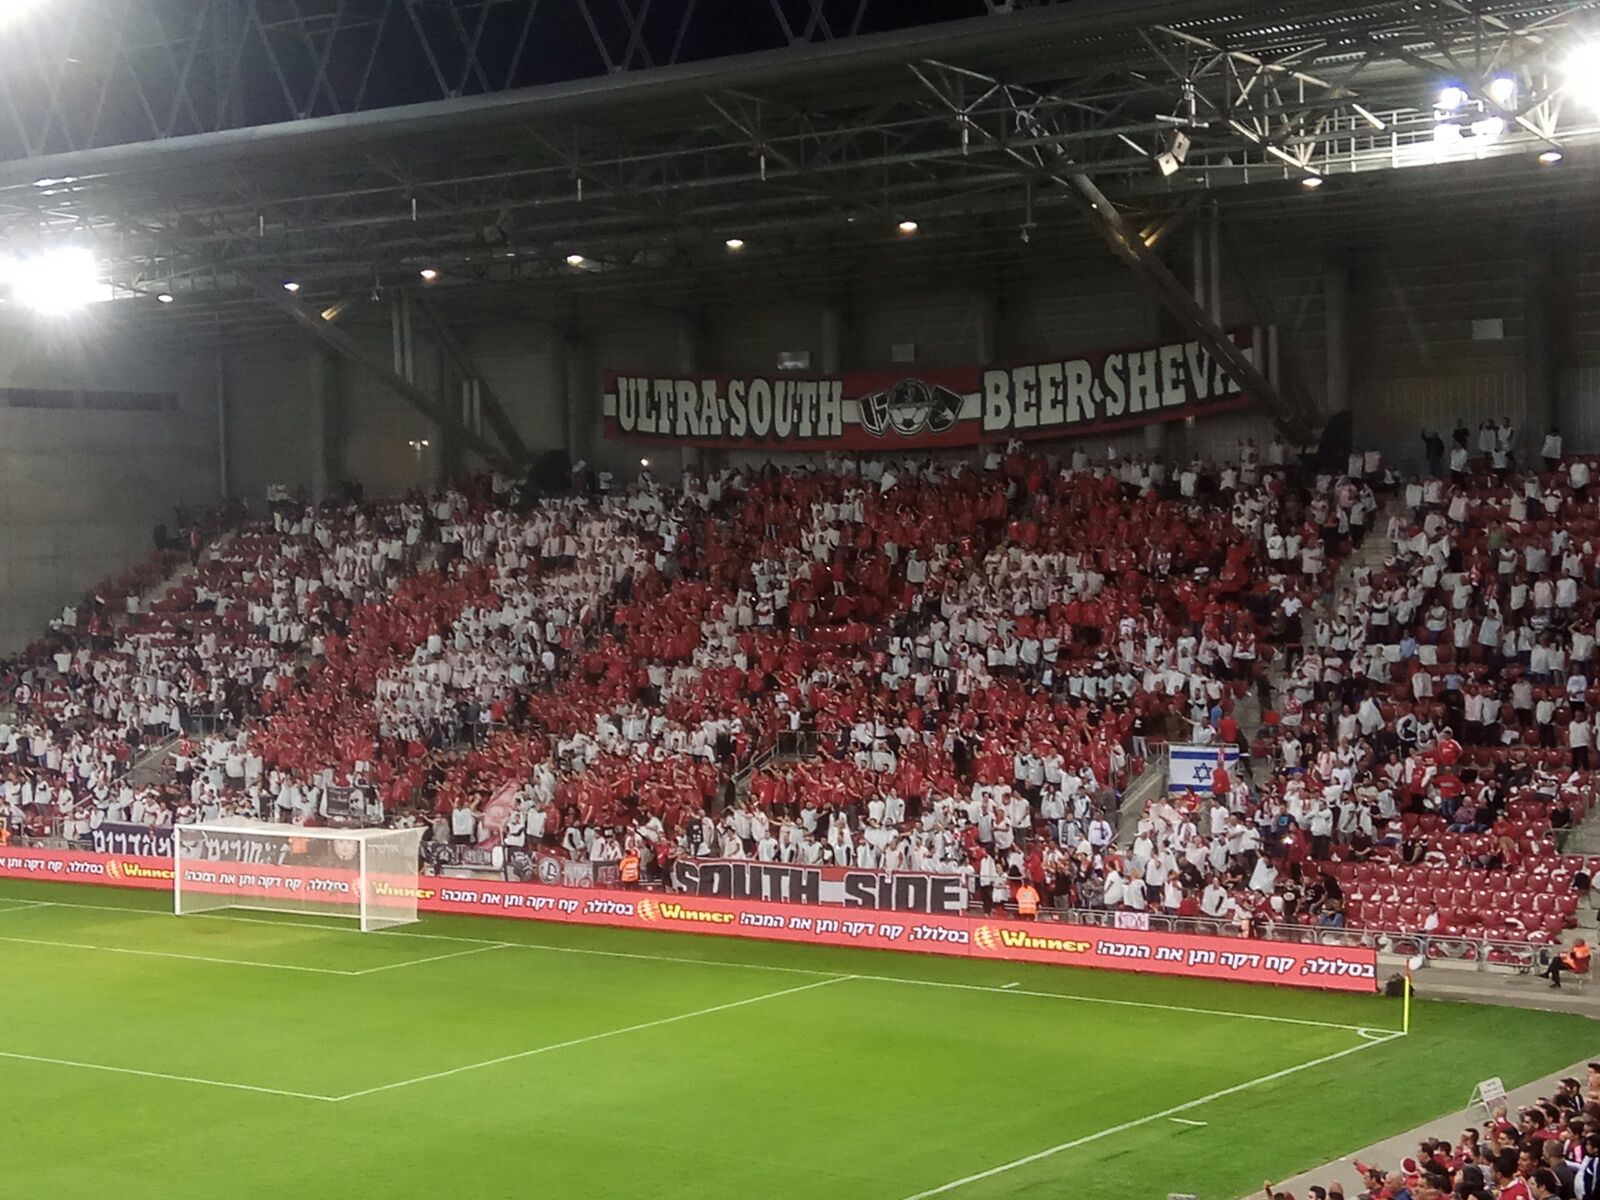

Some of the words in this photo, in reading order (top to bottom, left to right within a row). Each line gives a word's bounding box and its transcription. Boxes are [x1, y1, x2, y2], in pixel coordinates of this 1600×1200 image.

[983, 358, 1095, 430] BEER
[617, 377, 722, 436] ULTRA
[728, 378, 843, 437] SOUTH
[24, 859, 45, 871] דקה
[48, 860, 63, 872] קח
[219, 873, 236, 884] את
[258, 875, 282, 888] דקה
[675, 860, 821, 904] SOUTH
[441, 888, 477, 904] המכה!
[480, 893, 500, 905] את
[504, 894, 523, 909] ותן
[526, 895, 554, 911] דקה
[557, 898, 579, 914] קח
[583, 899, 634, 915] בסלולר,
[660, 902, 735, 923] Winner
[740, 912, 785, 927] המכה!
[789, 918, 812, 931] את
[815, 919, 838, 934] ותן
[842, 920, 875, 937] דקה
[879, 924, 904, 940] קח
[909, 925, 969, 944] בסלולר,
[1000, 929, 1091, 952] Winner
[1097, 940, 1151, 958] המכה!
[1155, 947, 1183, 962] את
[1187, 949, 1216, 966] ותן
[1220, 952, 1260, 969] דקה
[1264, 955, 1295, 974] קח
[1301, 956, 1375, 978] בסלולר,
